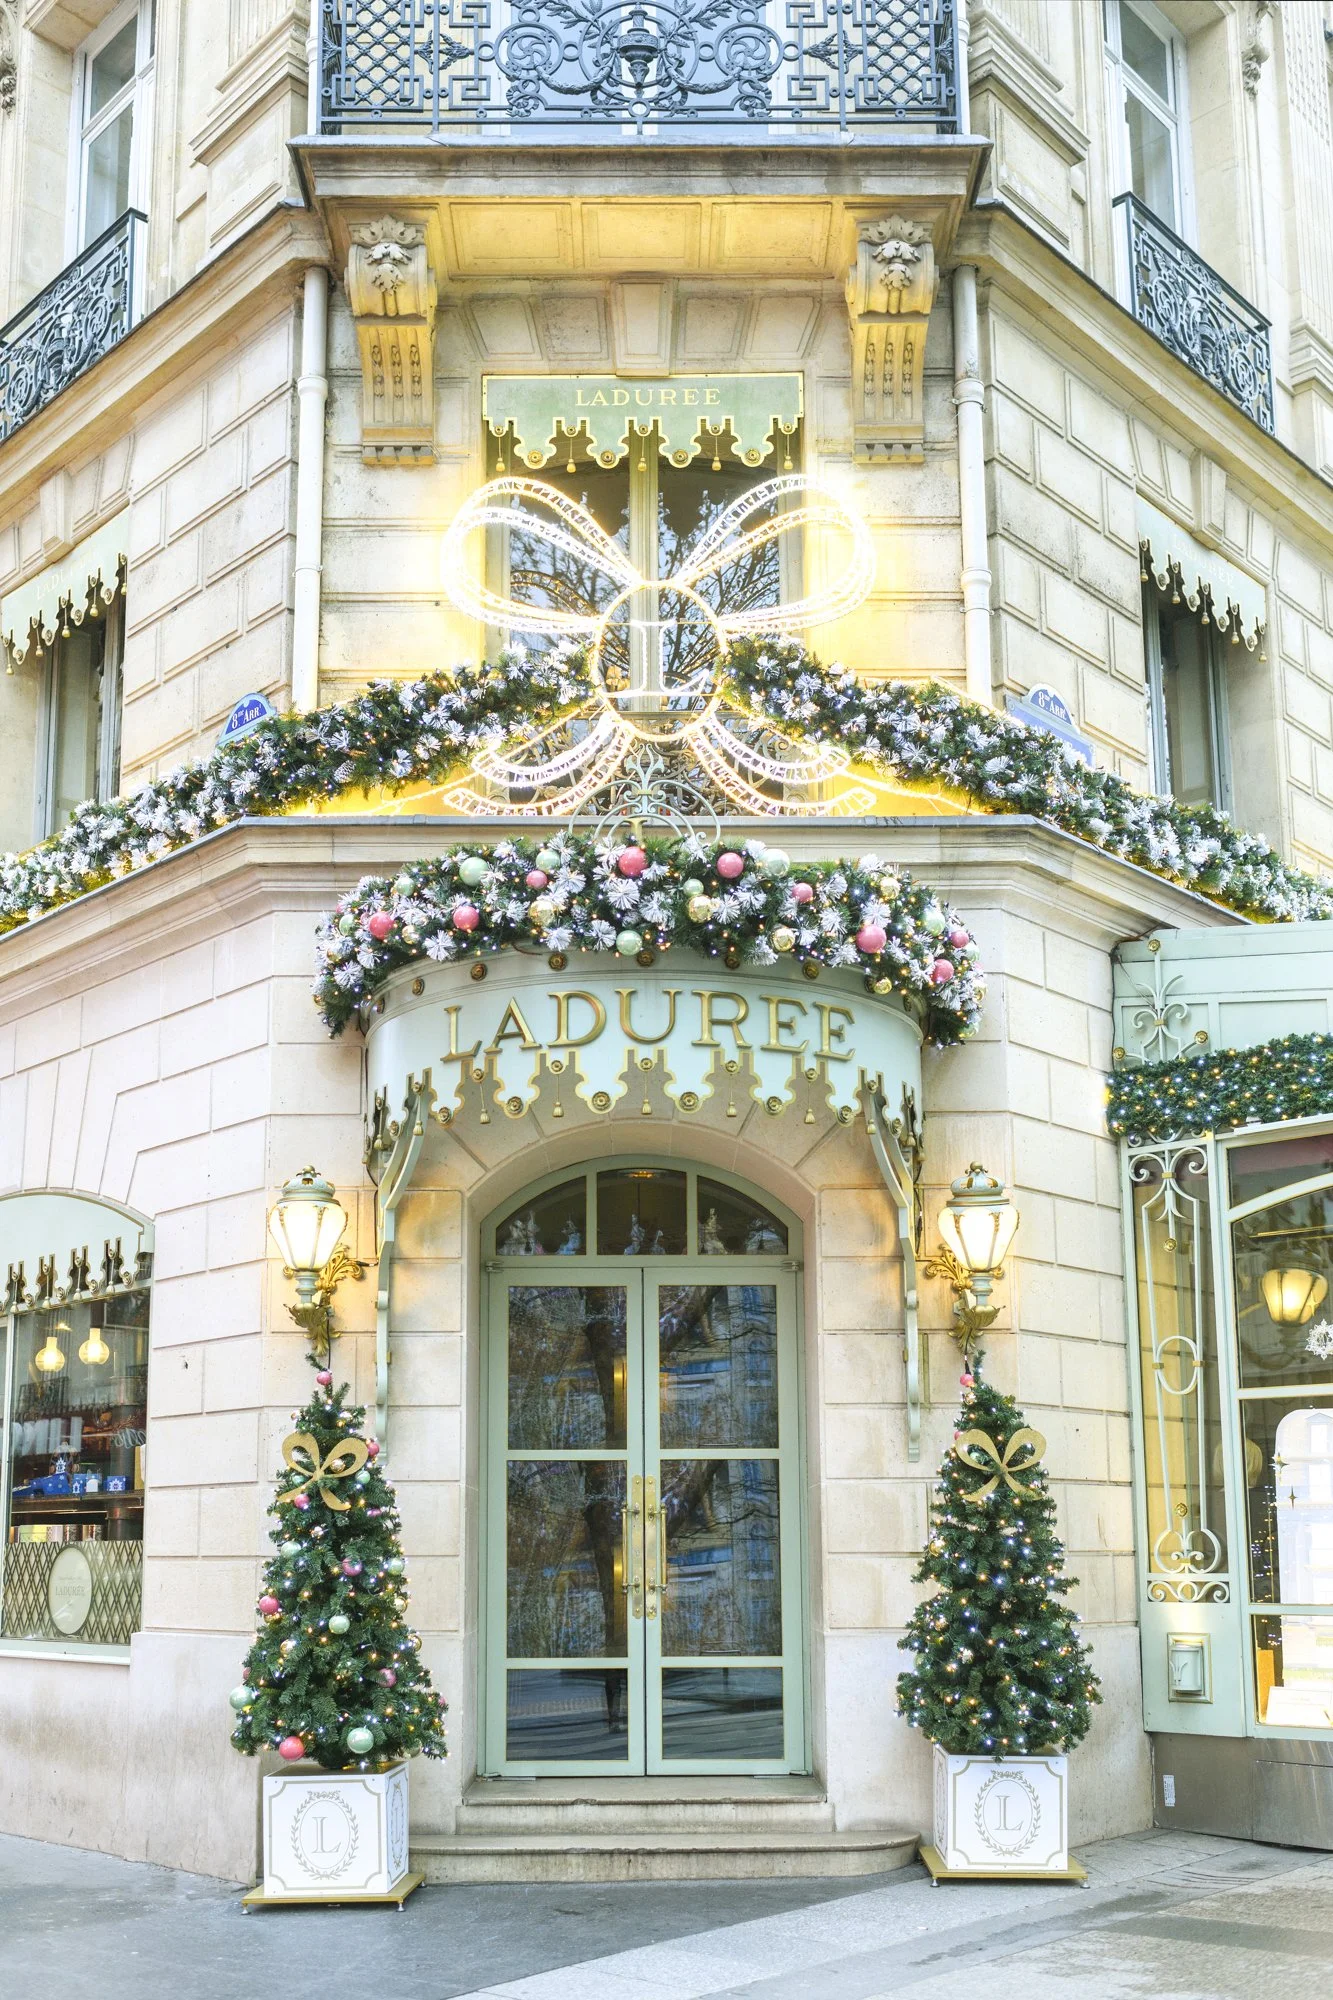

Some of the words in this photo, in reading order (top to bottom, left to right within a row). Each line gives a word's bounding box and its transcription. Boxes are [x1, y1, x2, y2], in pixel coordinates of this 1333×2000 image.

[575, 388, 721, 406] LADUREE
[440, 988, 856, 1062] LADUREE
[993, 1795, 1024, 1831] L
[311, 1816, 342, 1853] L
